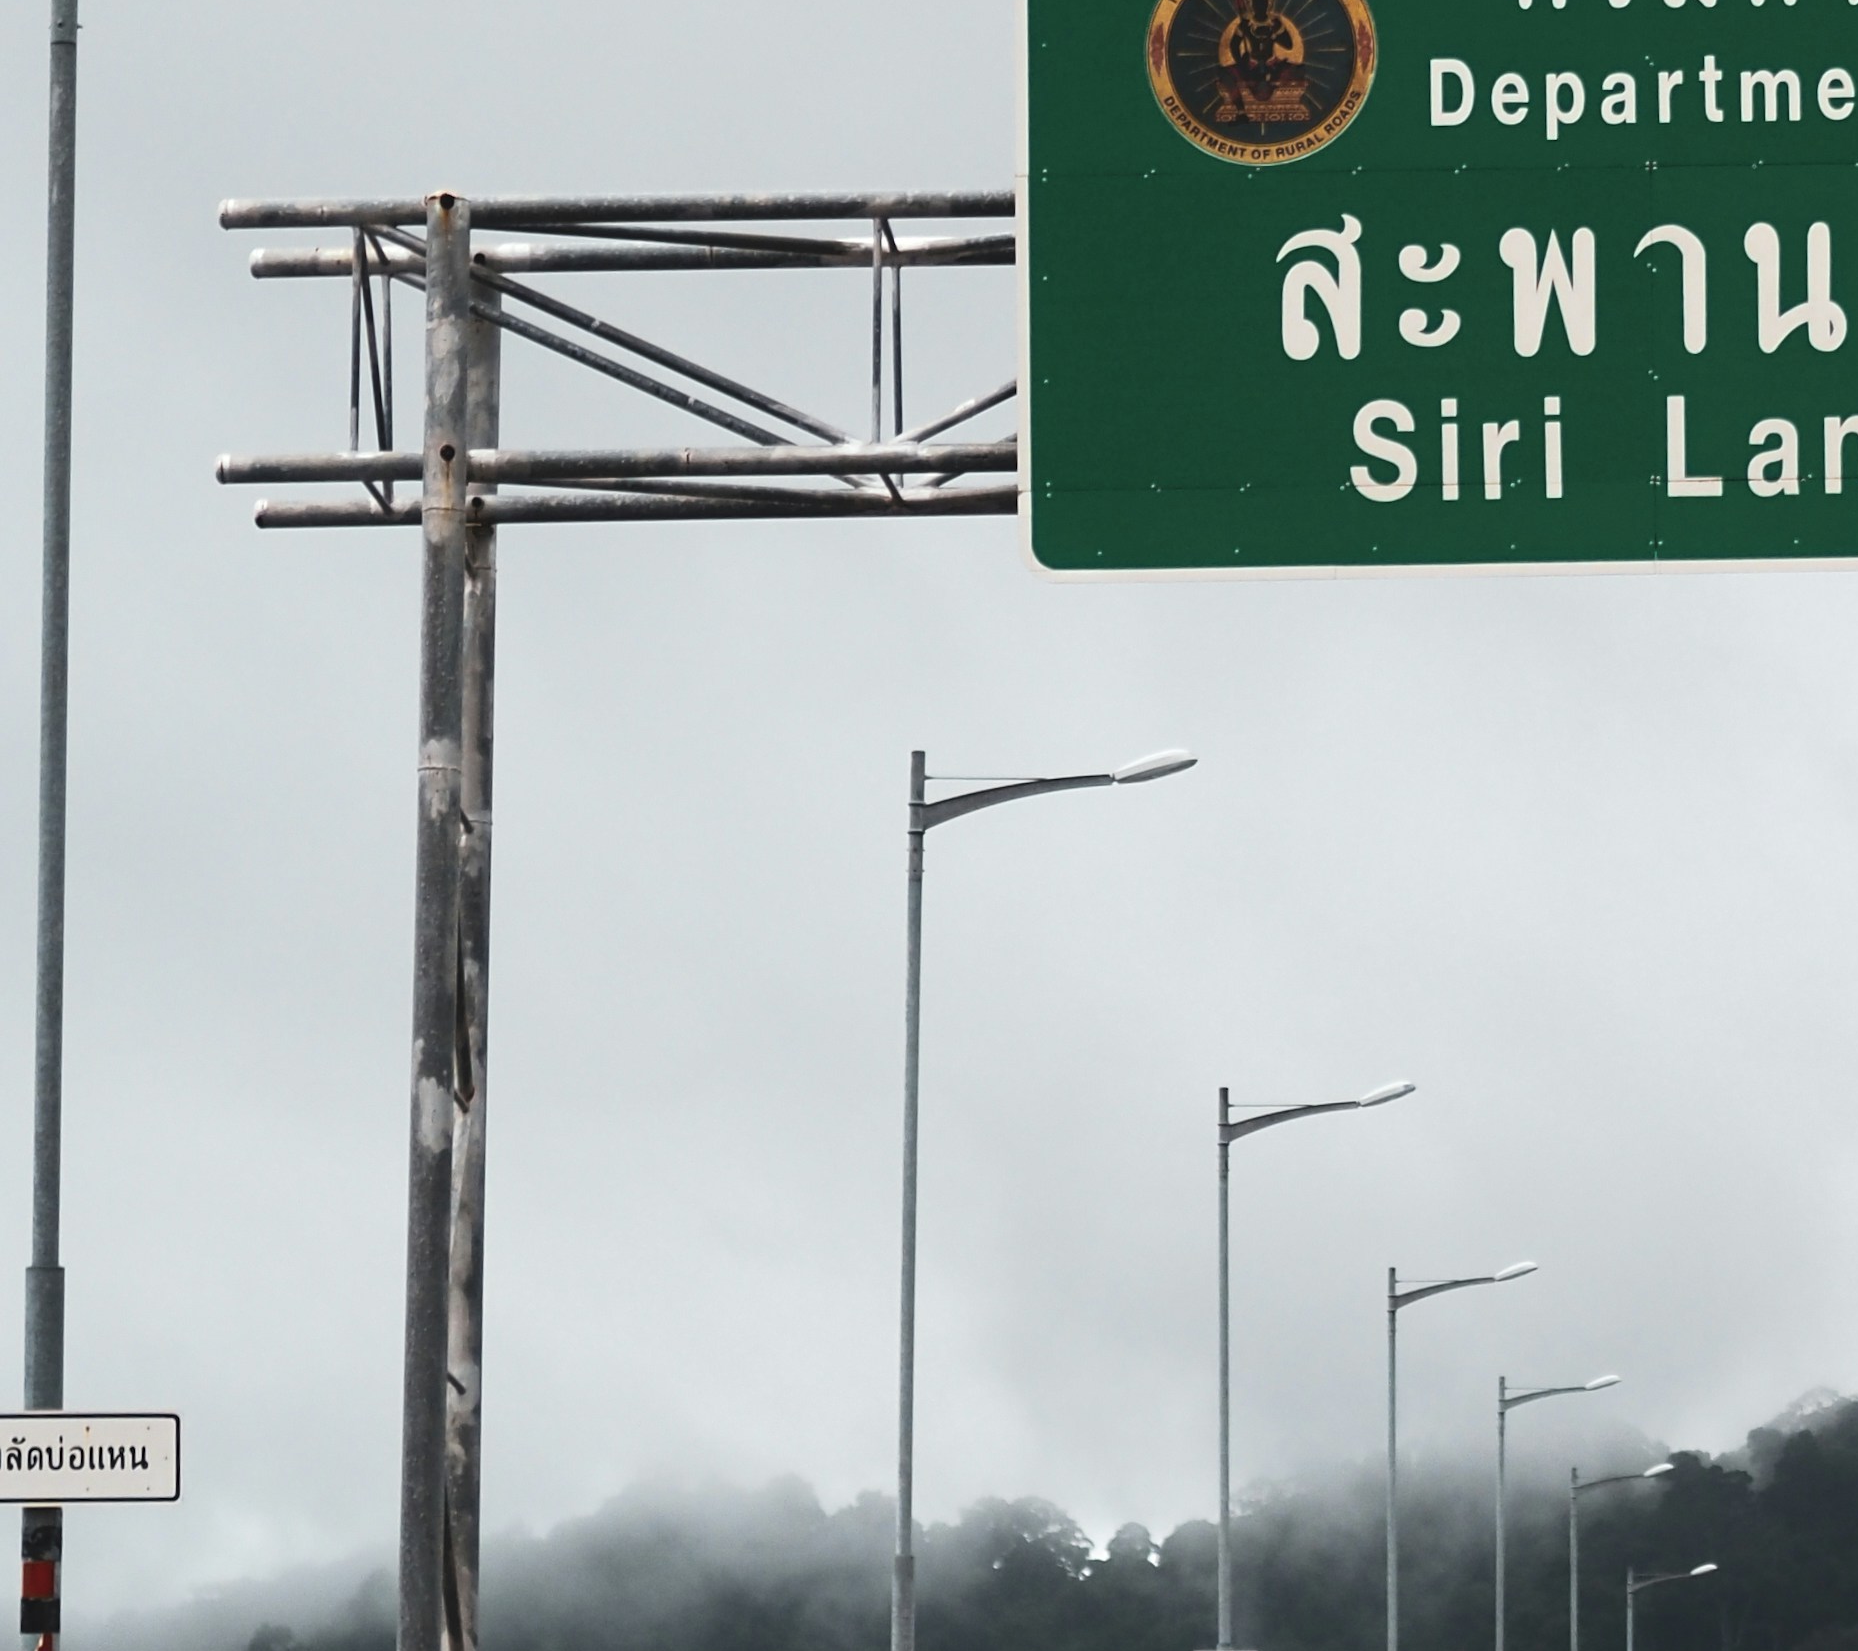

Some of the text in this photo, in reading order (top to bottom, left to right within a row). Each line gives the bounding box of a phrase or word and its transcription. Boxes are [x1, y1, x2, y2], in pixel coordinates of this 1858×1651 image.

[1163, 89, 1362, 161] DEPARTMENT OF RURAL ROADS
[1349, 395, 1563, 502] Siri
[0, 1435, 149, 1471] ลัดบ่อแหน
